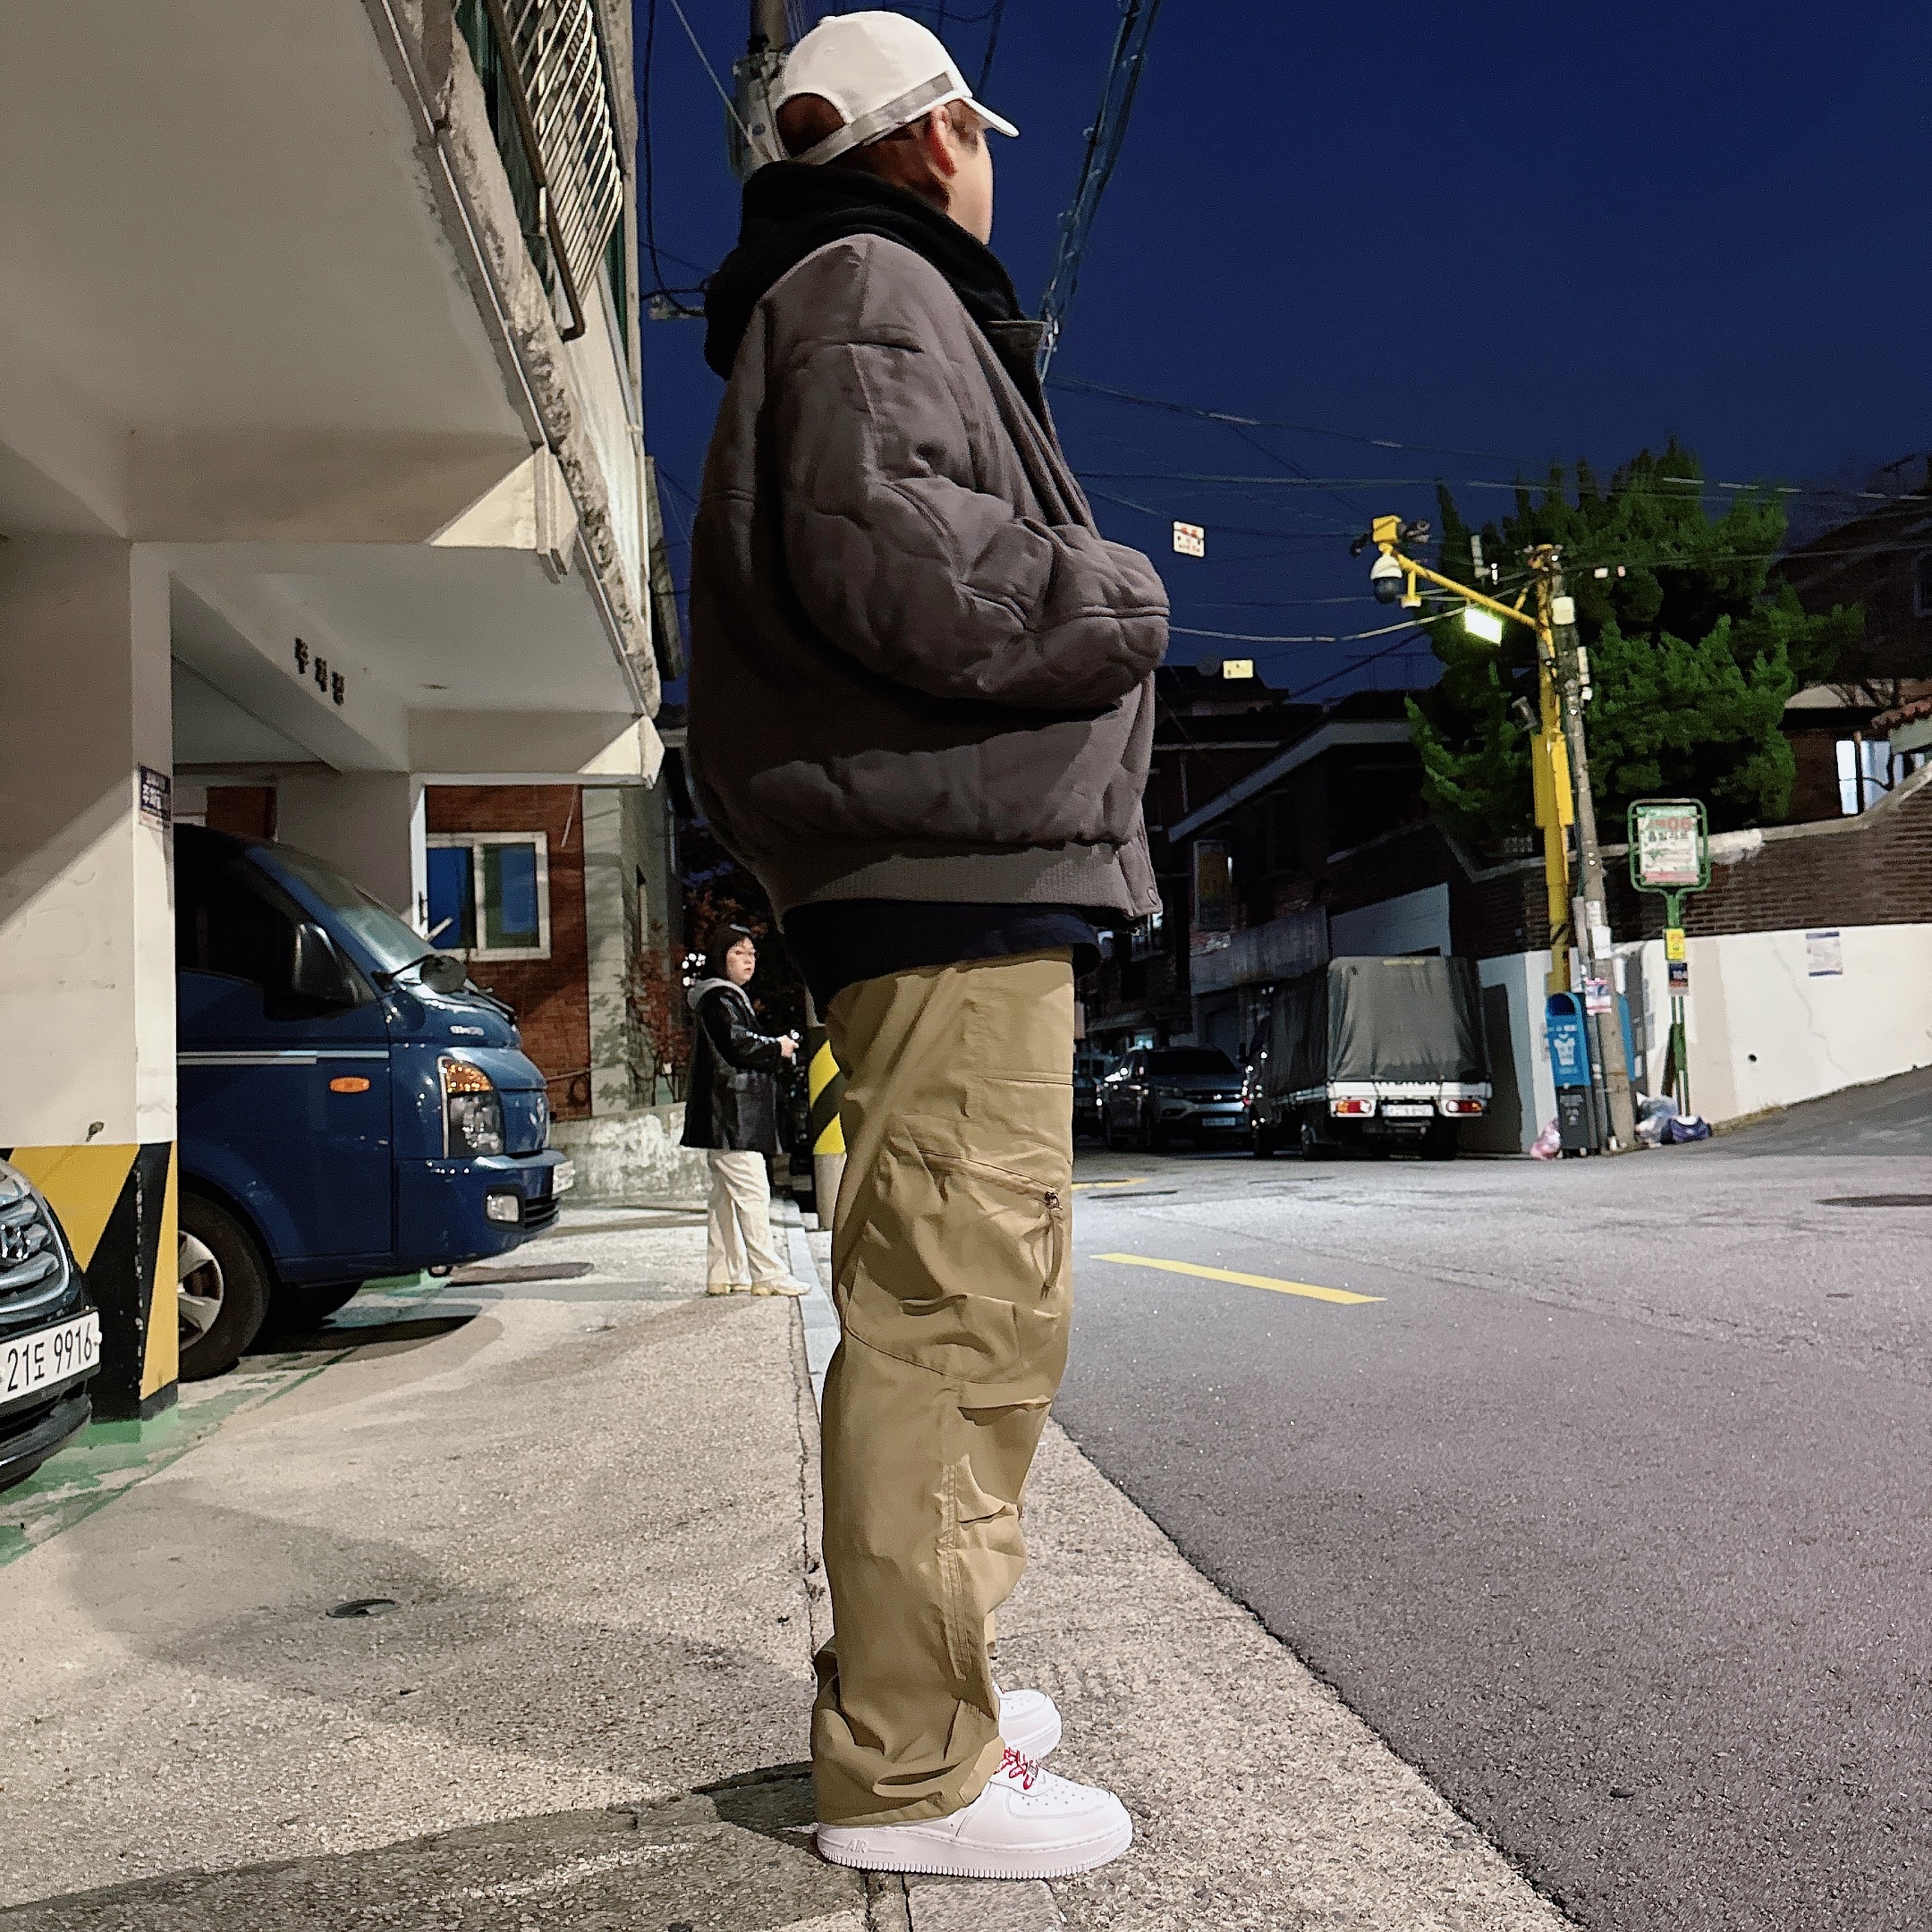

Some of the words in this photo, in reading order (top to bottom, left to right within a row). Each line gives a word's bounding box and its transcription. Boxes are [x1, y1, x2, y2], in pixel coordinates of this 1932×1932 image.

[7, 1342, 45, 1392] 21도
[54, 1321, 92, 1374] 9916
[844, 1838, 867, 1853] AIR
